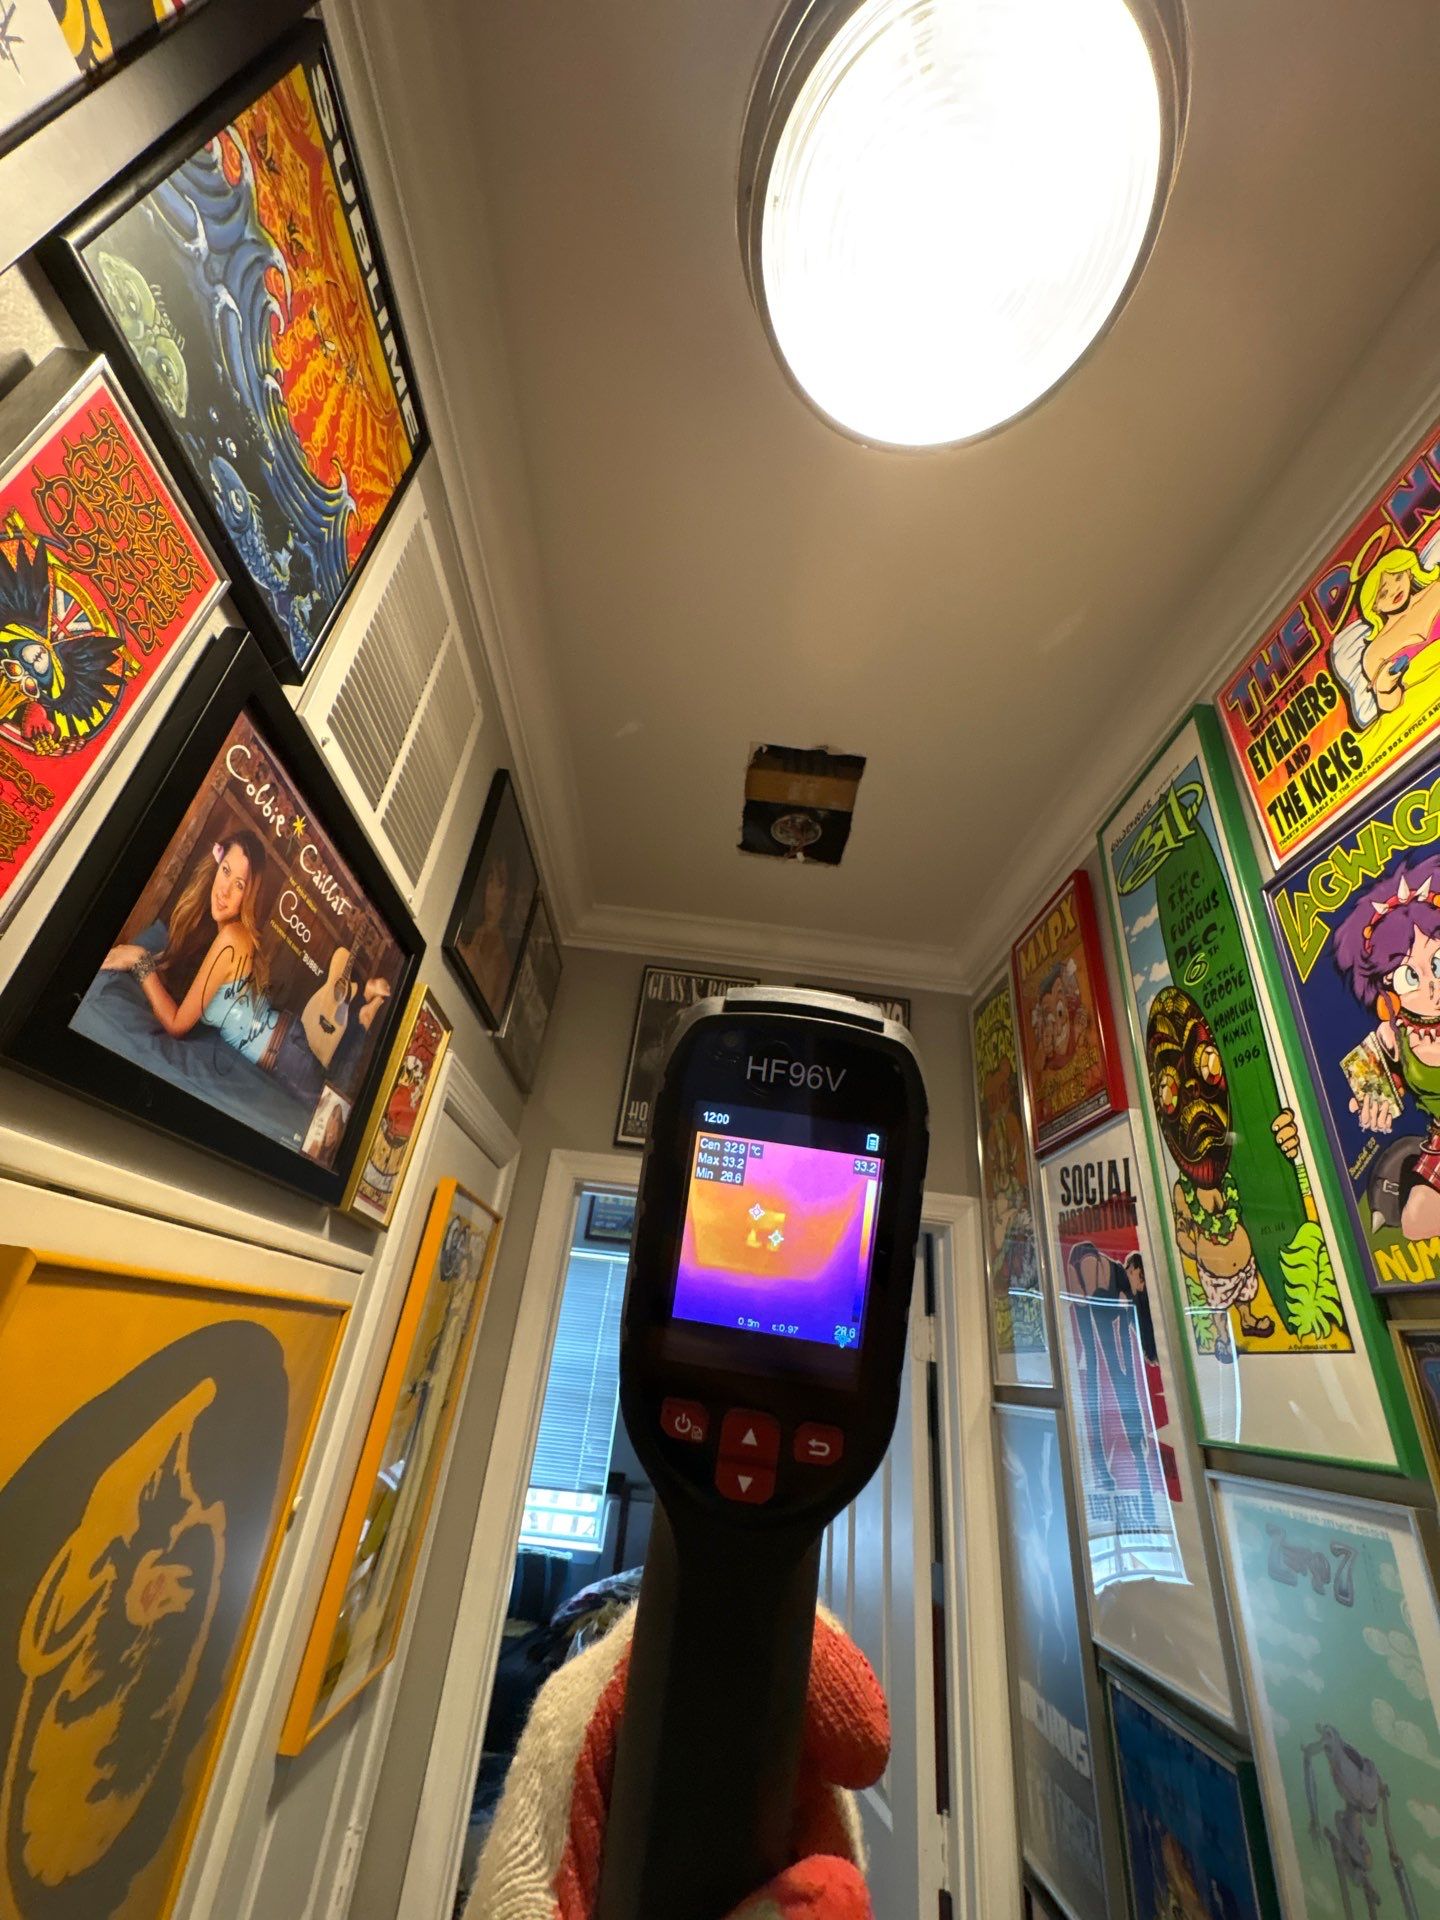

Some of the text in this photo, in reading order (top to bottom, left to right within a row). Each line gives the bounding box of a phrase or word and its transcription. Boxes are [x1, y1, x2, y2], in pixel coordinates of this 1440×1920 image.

[311, 63, 419, 447] SUBLIME
[1225, 601, 1321, 726] THE
[1247, 671, 1338, 783] EYELINERS
[1284, 743, 1312, 779] AND
[1300, 801, 1329, 829] AVAILABLE
[1388, 737, 1403, 753] BOX
[1404, 715, 1428, 739] OFFICE
[1267, 779, 1307, 837] THE
[1300, 731, 1364, 810] KICKS
[226, 744, 353, 916] Colbie Caillat
[279, 890, 311, 943] Coco
[1170, 888, 1219, 943] FUNGUS
[1203, 969, 1246, 1009] GROOVE
[746, 1056, 847, 1092] HF96V
[1233, 1045, 1260, 1068] 1996
[703, 1111, 730, 1125] 1200
[698, 1152, 744, 1169] Max 33.2
[699, 1138, 720, 1151] Cen
[696, 1167, 742, 1184] Min 28.6
[854, 1160, 877, 1173] 33.2
[1060, 1157, 1138, 1207] SOCIAL
[1058, 1199, 1139, 1238] DISTORTION
